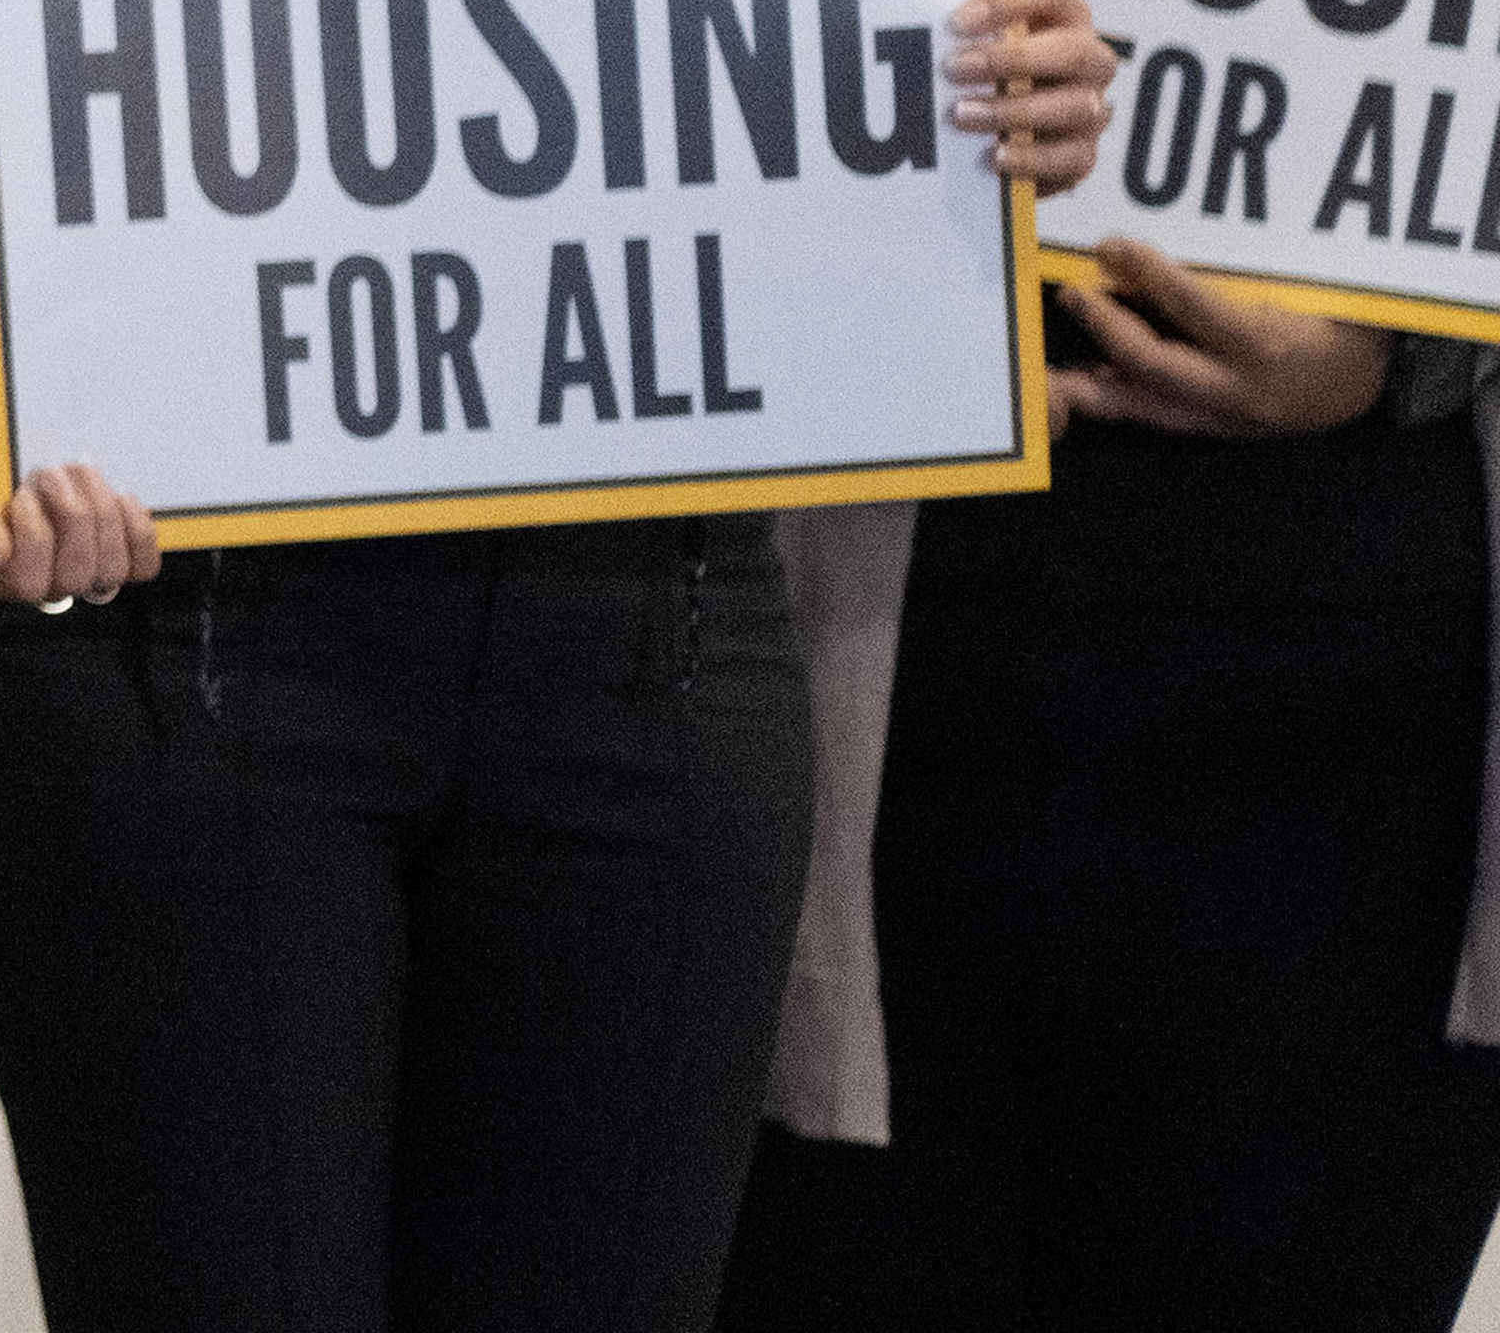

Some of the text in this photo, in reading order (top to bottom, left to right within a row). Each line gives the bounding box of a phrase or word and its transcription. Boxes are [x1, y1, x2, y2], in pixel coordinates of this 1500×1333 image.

[1102, 35, 1289, 222] OR
[256, 234, 764, 444] FOR ALL
